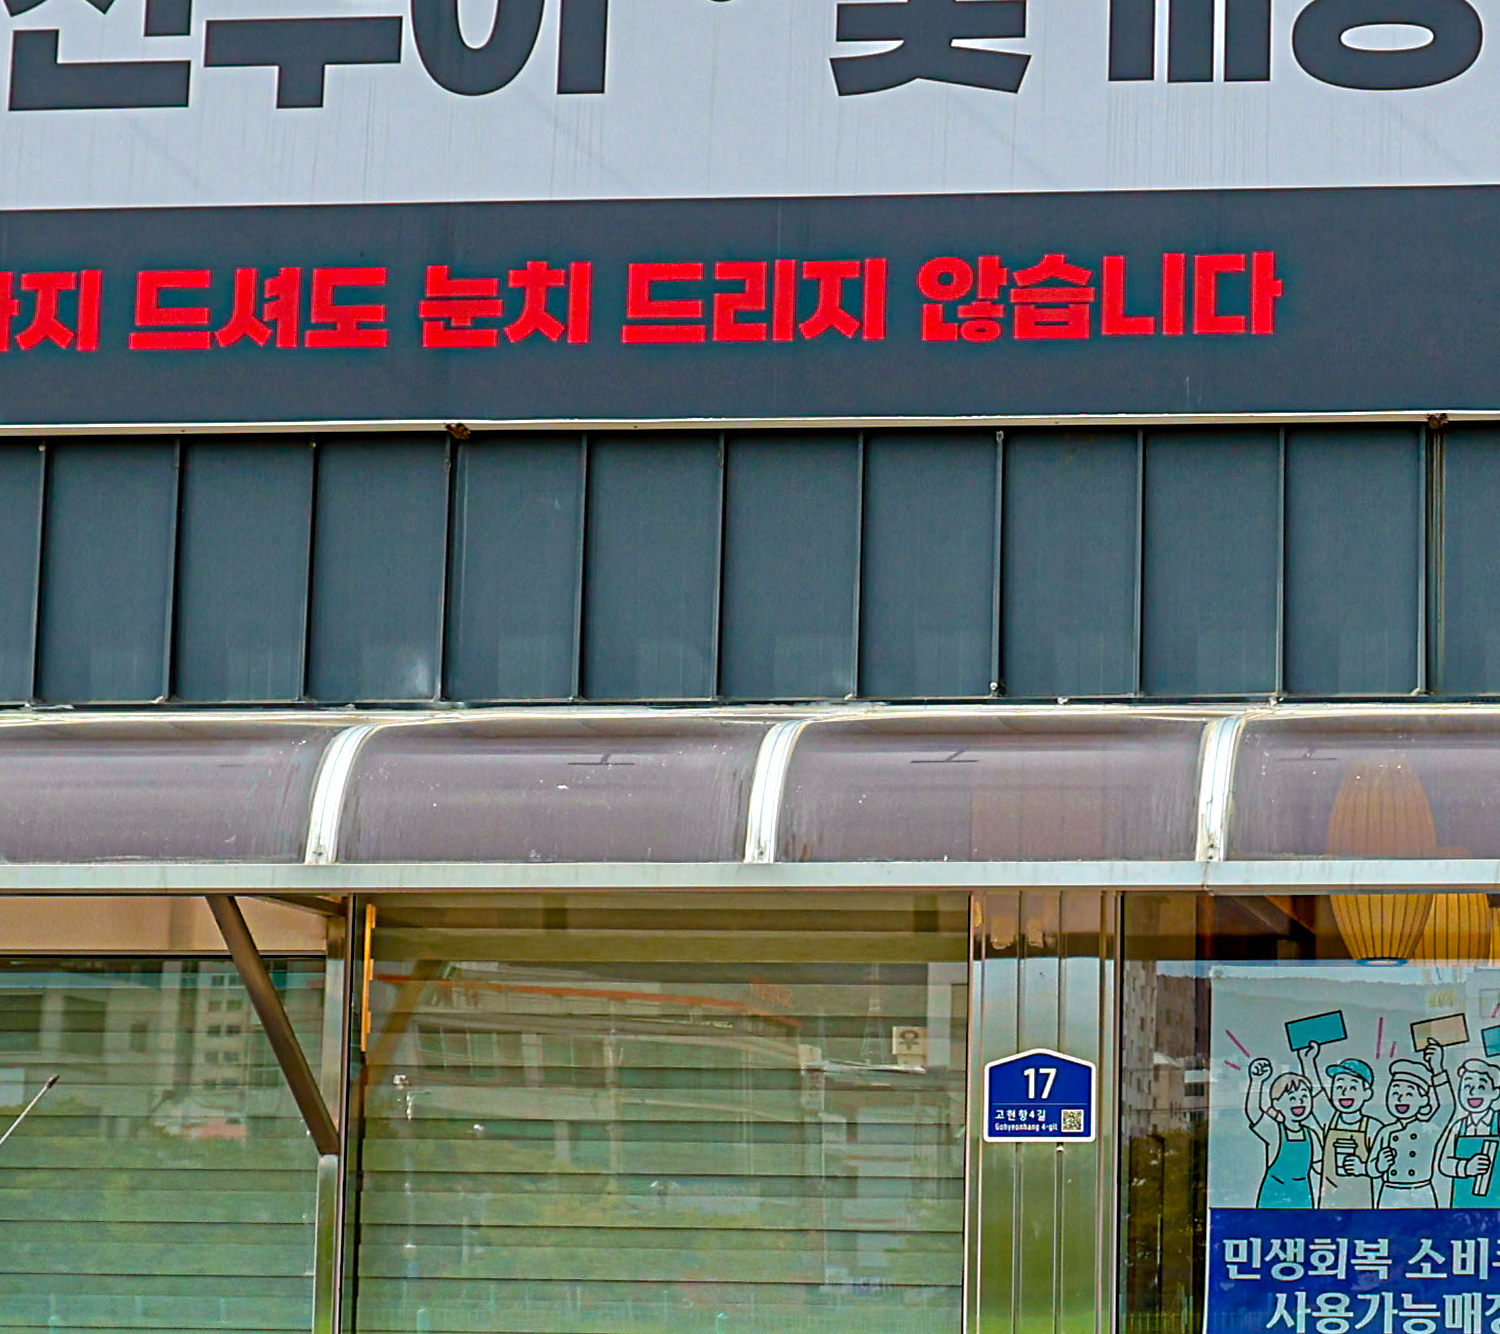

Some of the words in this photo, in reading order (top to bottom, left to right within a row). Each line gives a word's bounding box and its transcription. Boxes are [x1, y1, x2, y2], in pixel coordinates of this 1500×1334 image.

[129, 264, 389, 350] 드셔도
[418, 261, 591, 349] 눈치
[623, 257, 887, 345] 드리지
[919, 251, 1283, 345] 않습니다
[1023, 1068, 1057, 1098] 17
[1223, 1237, 1392, 1282] 민생회복
